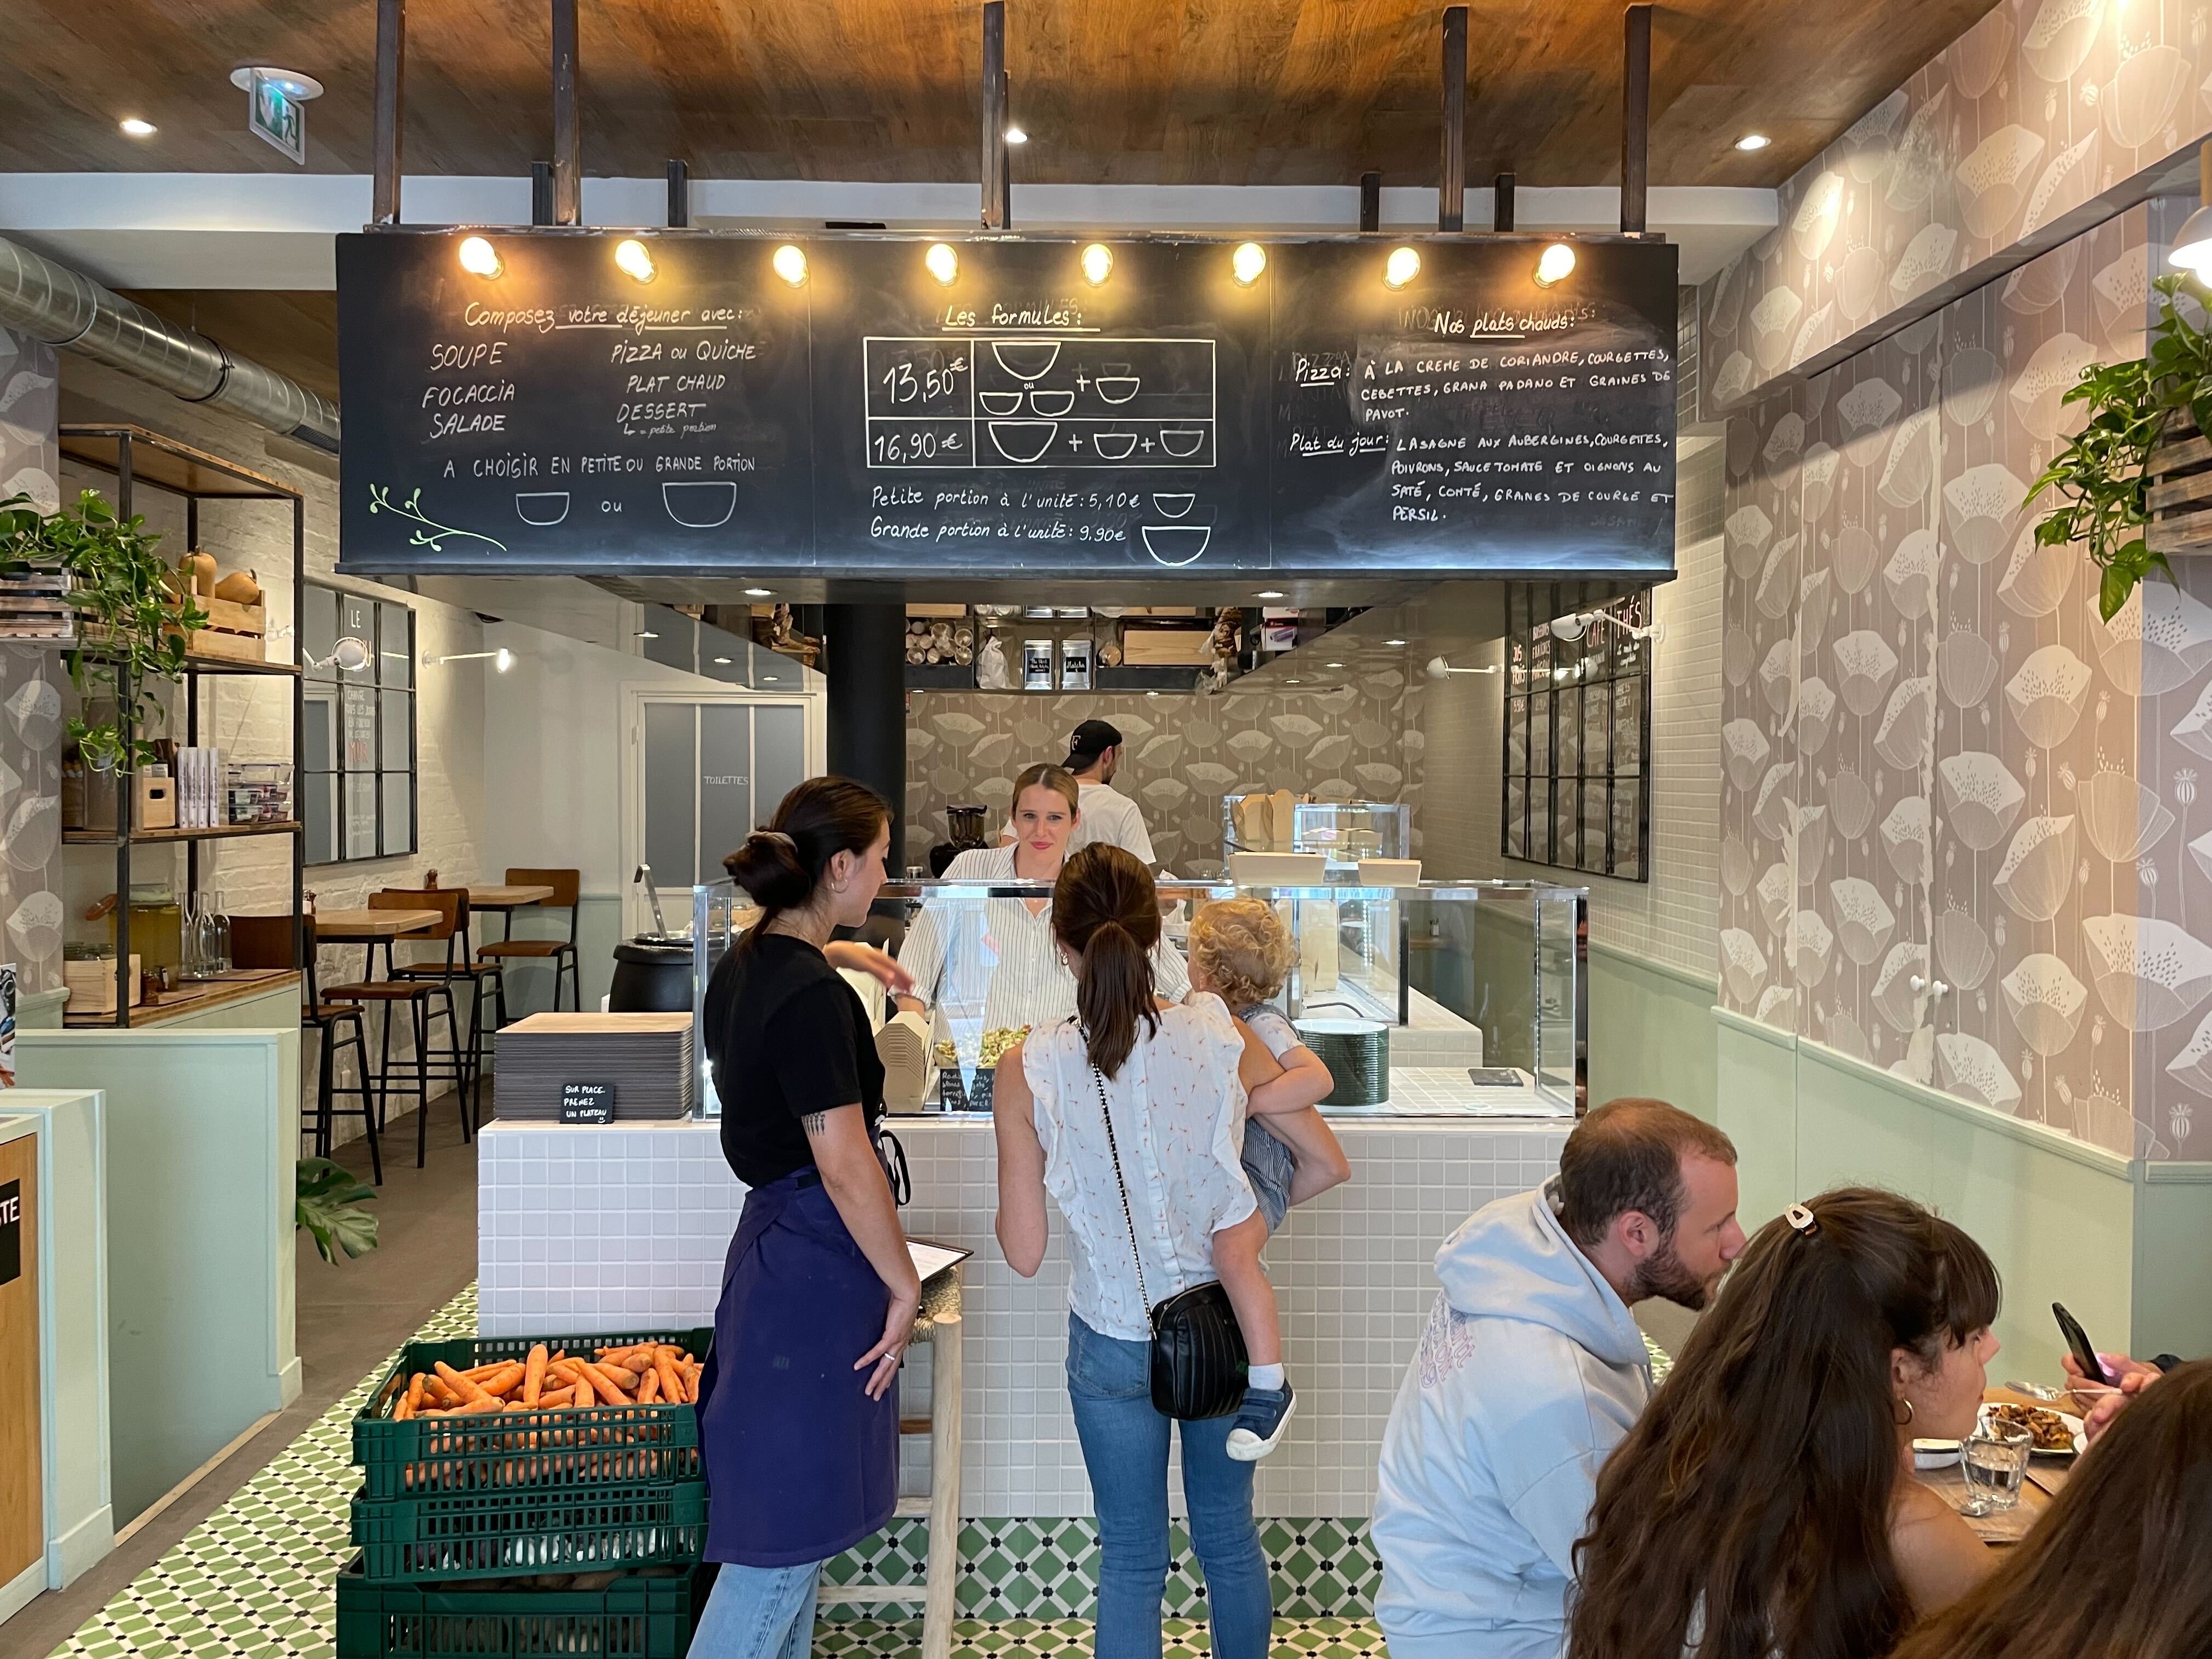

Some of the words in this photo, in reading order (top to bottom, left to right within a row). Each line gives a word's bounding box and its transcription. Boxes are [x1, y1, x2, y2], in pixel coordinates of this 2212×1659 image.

[465, 302, 555, 334] Composez
[569, 307, 607, 323] votre
[617, 306, 690, 336] déjeuner
[945, 304, 976, 327] Les
[1434, 311, 1465, 335] Nos
[1472, 312, 1515, 336] plats
[1519, 313, 1575, 332] chauds:
[431, 342, 508, 371] SOUPE
[1295, 358, 1351, 382] Pizza:
[1385, 360, 1404, 375] LA
[1469, 358, 1488, 369] DE
[626, 375, 670, 394] PLAT
[676, 374, 726, 392] CHAUD
[1443, 380, 1488, 394] GRANA
[1498, 378, 1553, 392] PADANO
[1559, 376, 1576, 388] ET
[1589, 374, 1646, 387] GRAINES
[1652, 370, 1671, 382] DE
[617, 403, 707, 423] DESSERT
[430, 414, 506, 439] SALADE
[1290, 433, 1321, 452] Plat
[1327, 435, 1345, 450] du
[1396, 437, 1466, 452] LASAGNE
[1477, 437, 1501, 448] AUX
[443, 460, 455, 478] A
[551, 456, 570, 474] EN
[656, 456, 702, 472] GRANDE
[1454, 461, 1491, 473] SAUCE
[1493, 461, 1543, 473] TOMATE
[1555, 461, 1574, 473] ET
[1583, 461, 1634, 474] OIGNONS
[1643, 461, 1661, 473] AU
[872, 486, 924, 508] Petite
[934, 492, 989, 510] portion
[1000, 493, 1010, 507] à
[1494, 489, 1550, 502] GRAINES
[1558, 491, 1580, 503] DE
[1588, 490, 1640, 502] COURGE
[1650, 493, 1674, 504] ET
[870, 515, 930, 539] Grande
[935, 524, 990, 543] portion
[997, 522, 1009, 537] à
[351, 610, 362, 628] LE
[703, 776, 749, 785] TOILETTES
[564, 1098, 595, 1106] PRENEZ
[580, 1109, 607, 1117] PLATEAU
